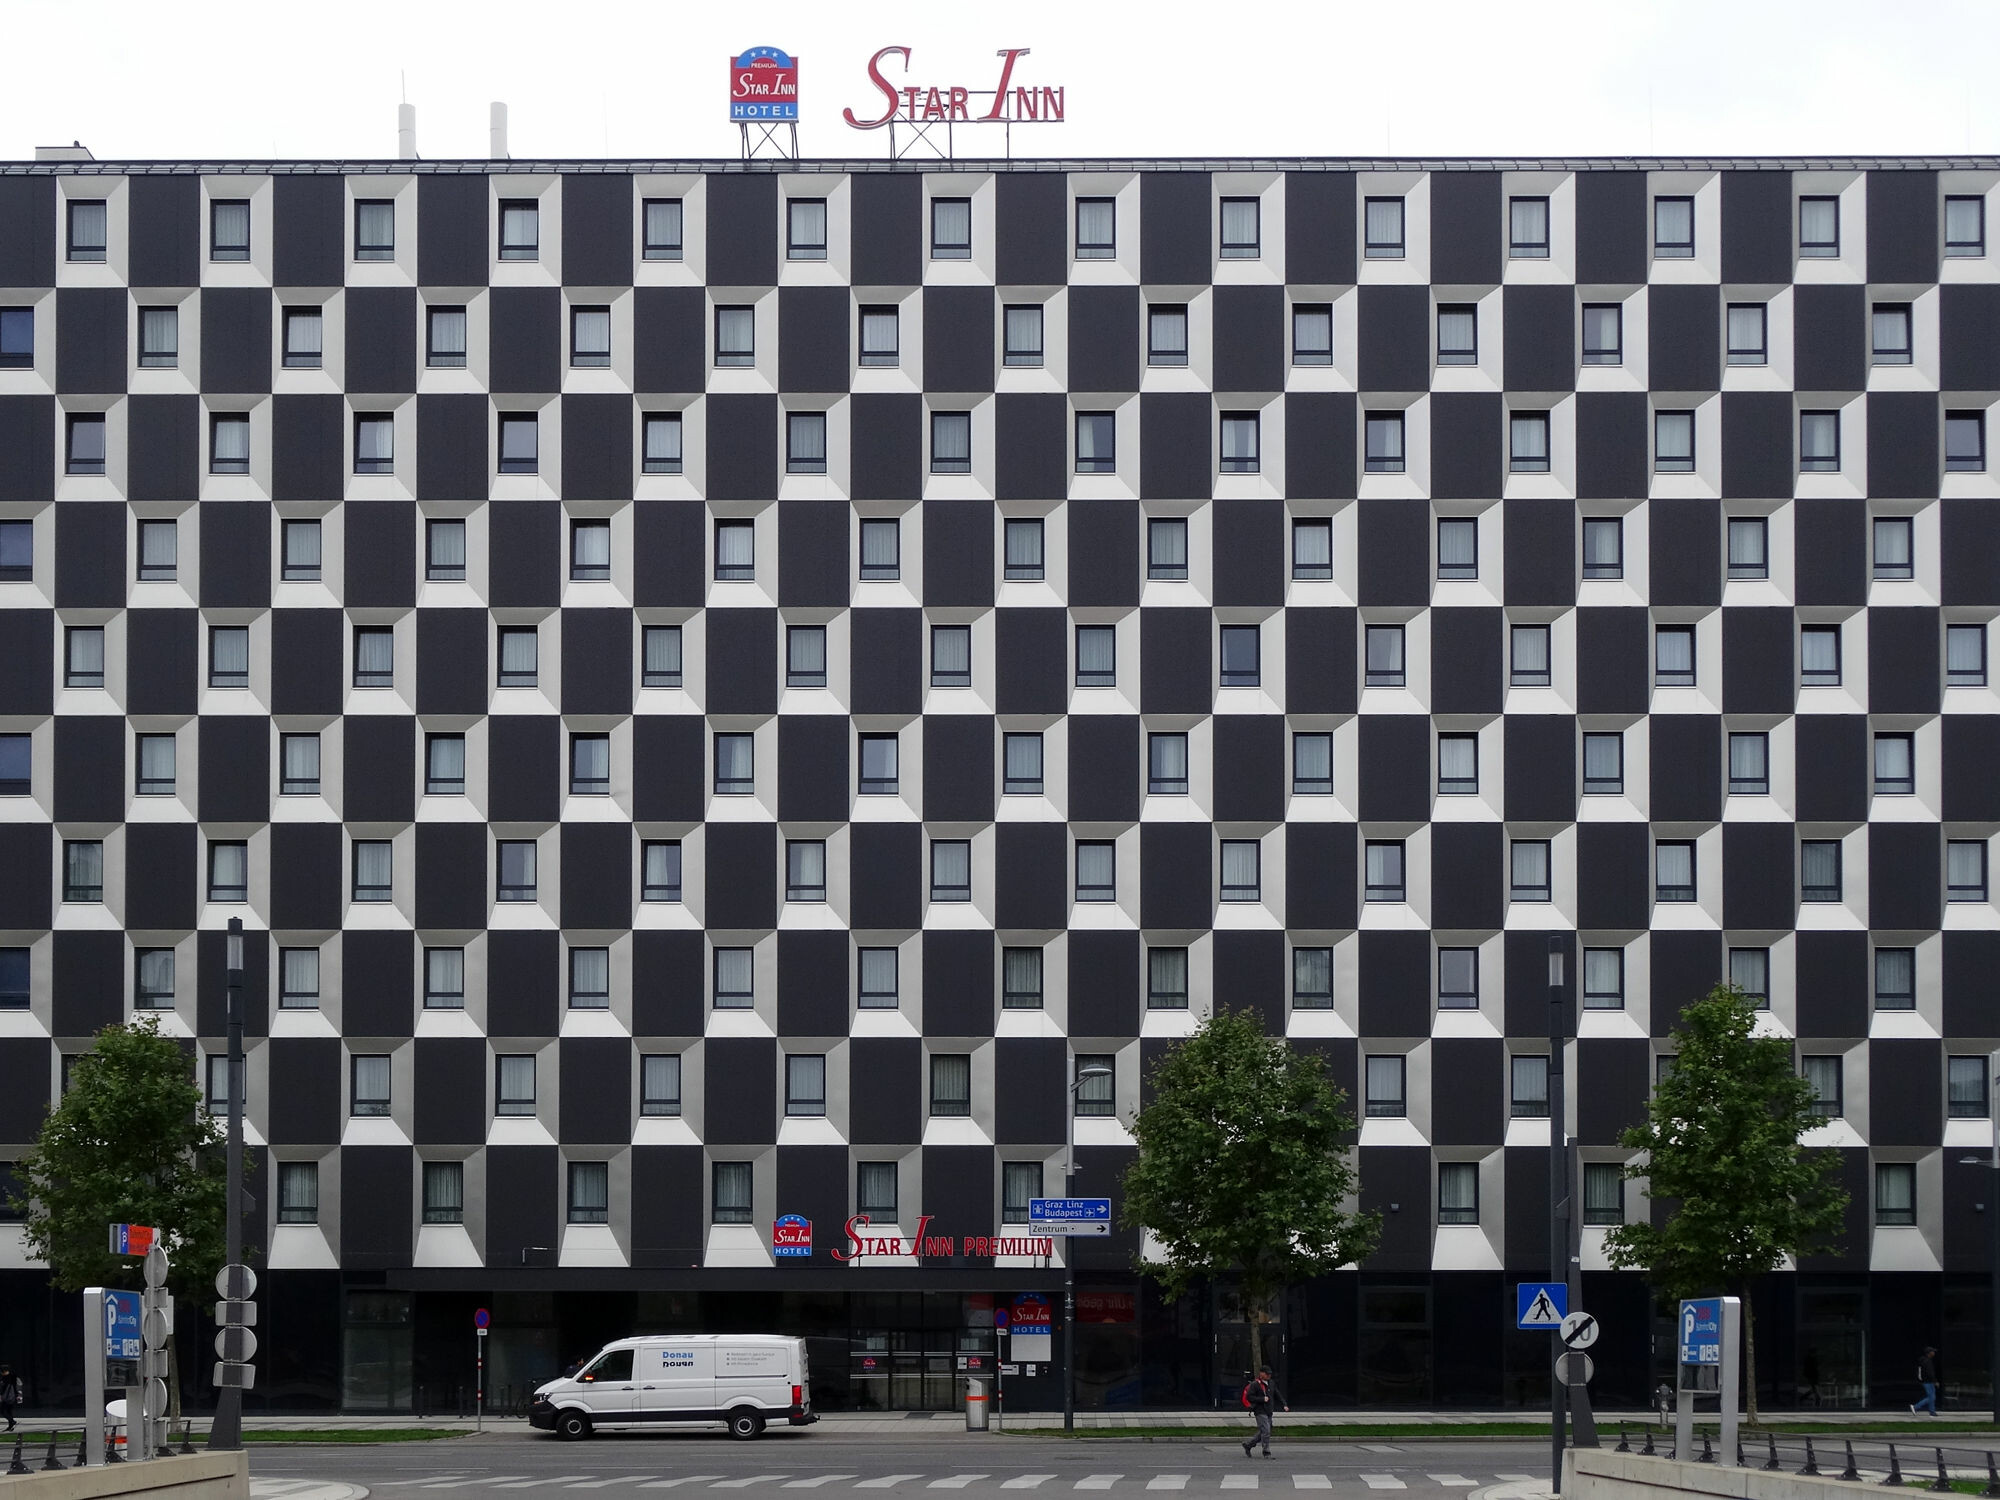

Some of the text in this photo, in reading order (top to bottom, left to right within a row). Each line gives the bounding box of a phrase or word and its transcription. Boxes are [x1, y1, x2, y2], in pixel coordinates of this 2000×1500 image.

[734, 105, 794, 116] HOTEL
[1044, 1200, 1084, 1208] Graz Linz
[1044, 1208, 1083, 1217] Budapest
[1032, 1225, 1068, 1233] Zentrum
[775, 1247, 809, 1255] HOTEL
[964, 1236, 1053, 1258] PREMIUM
[1013, 1326, 1049, 1334] HOTEL
[1568, 1319, 1592, 1342] 10
[662, 1351, 694, 1359] Donau
